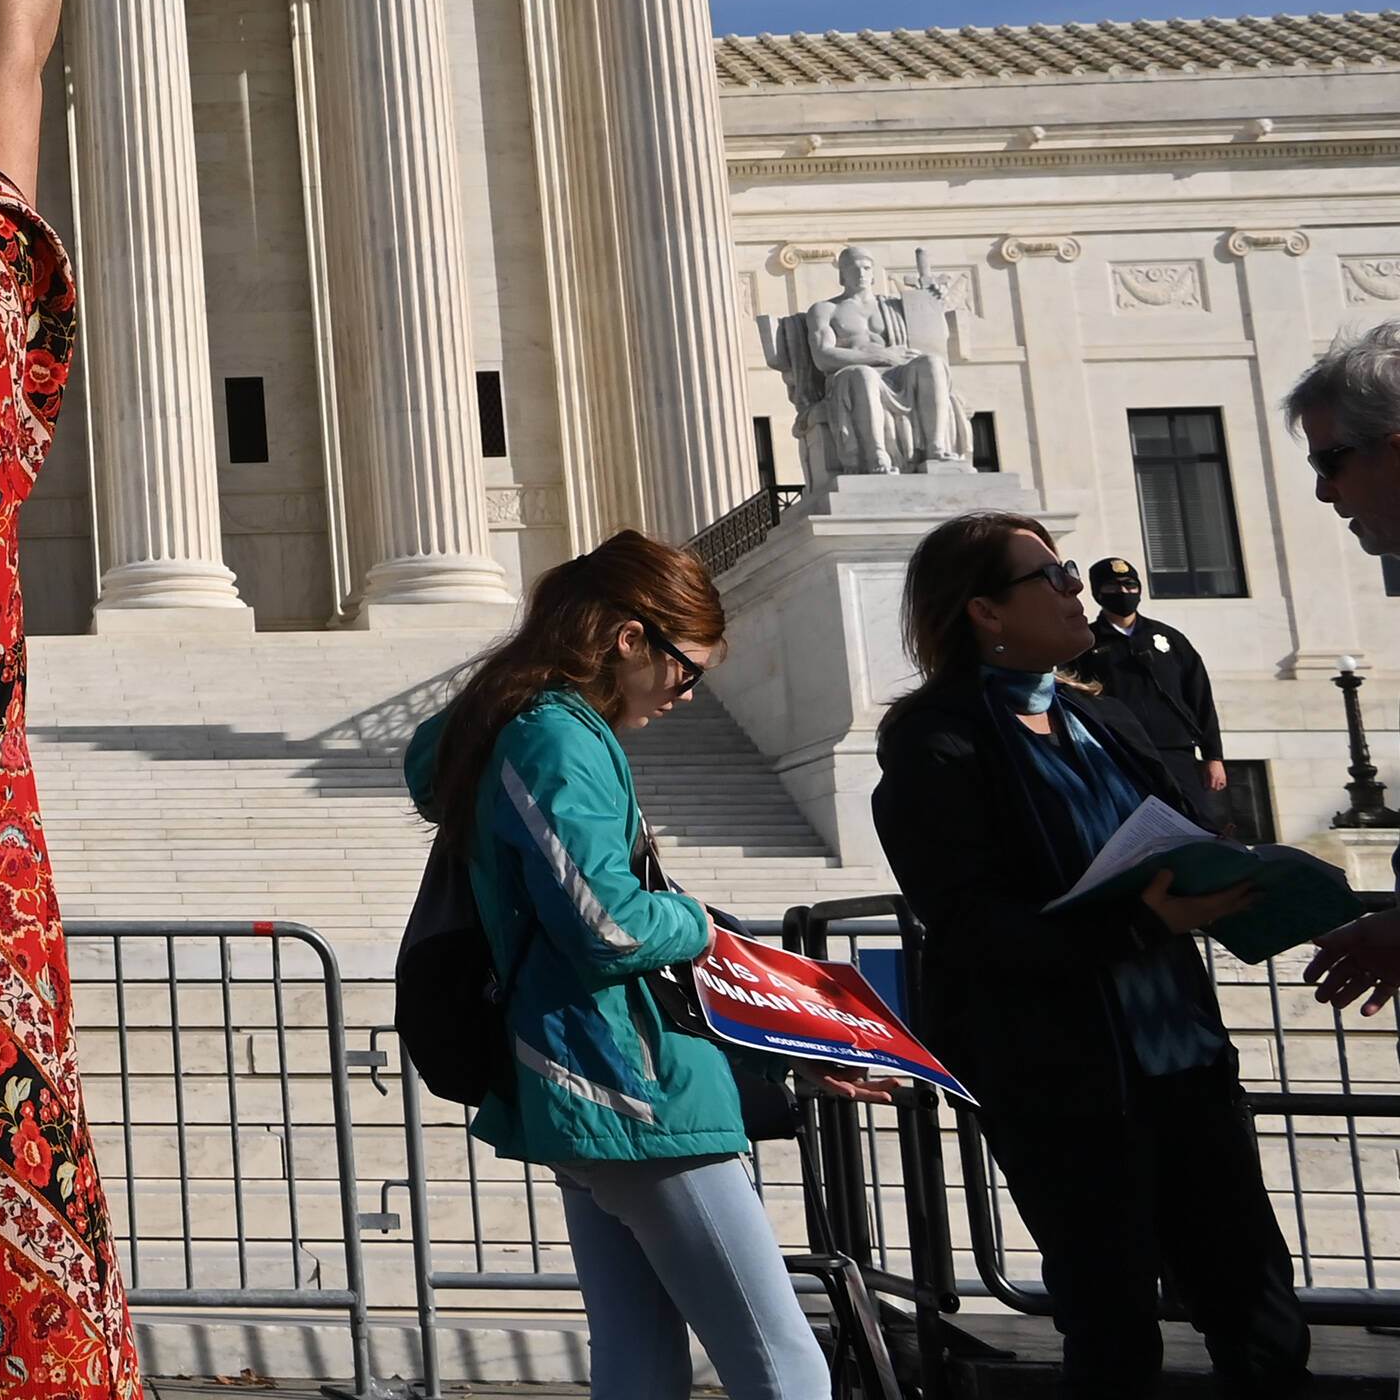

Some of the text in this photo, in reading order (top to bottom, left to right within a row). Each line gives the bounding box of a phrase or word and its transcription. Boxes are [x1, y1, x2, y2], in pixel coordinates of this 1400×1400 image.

[694, 965, 894, 1040] HUMAN RIGHT
[724, 957, 760, 983] IS
[767, 972, 795, 993] A
